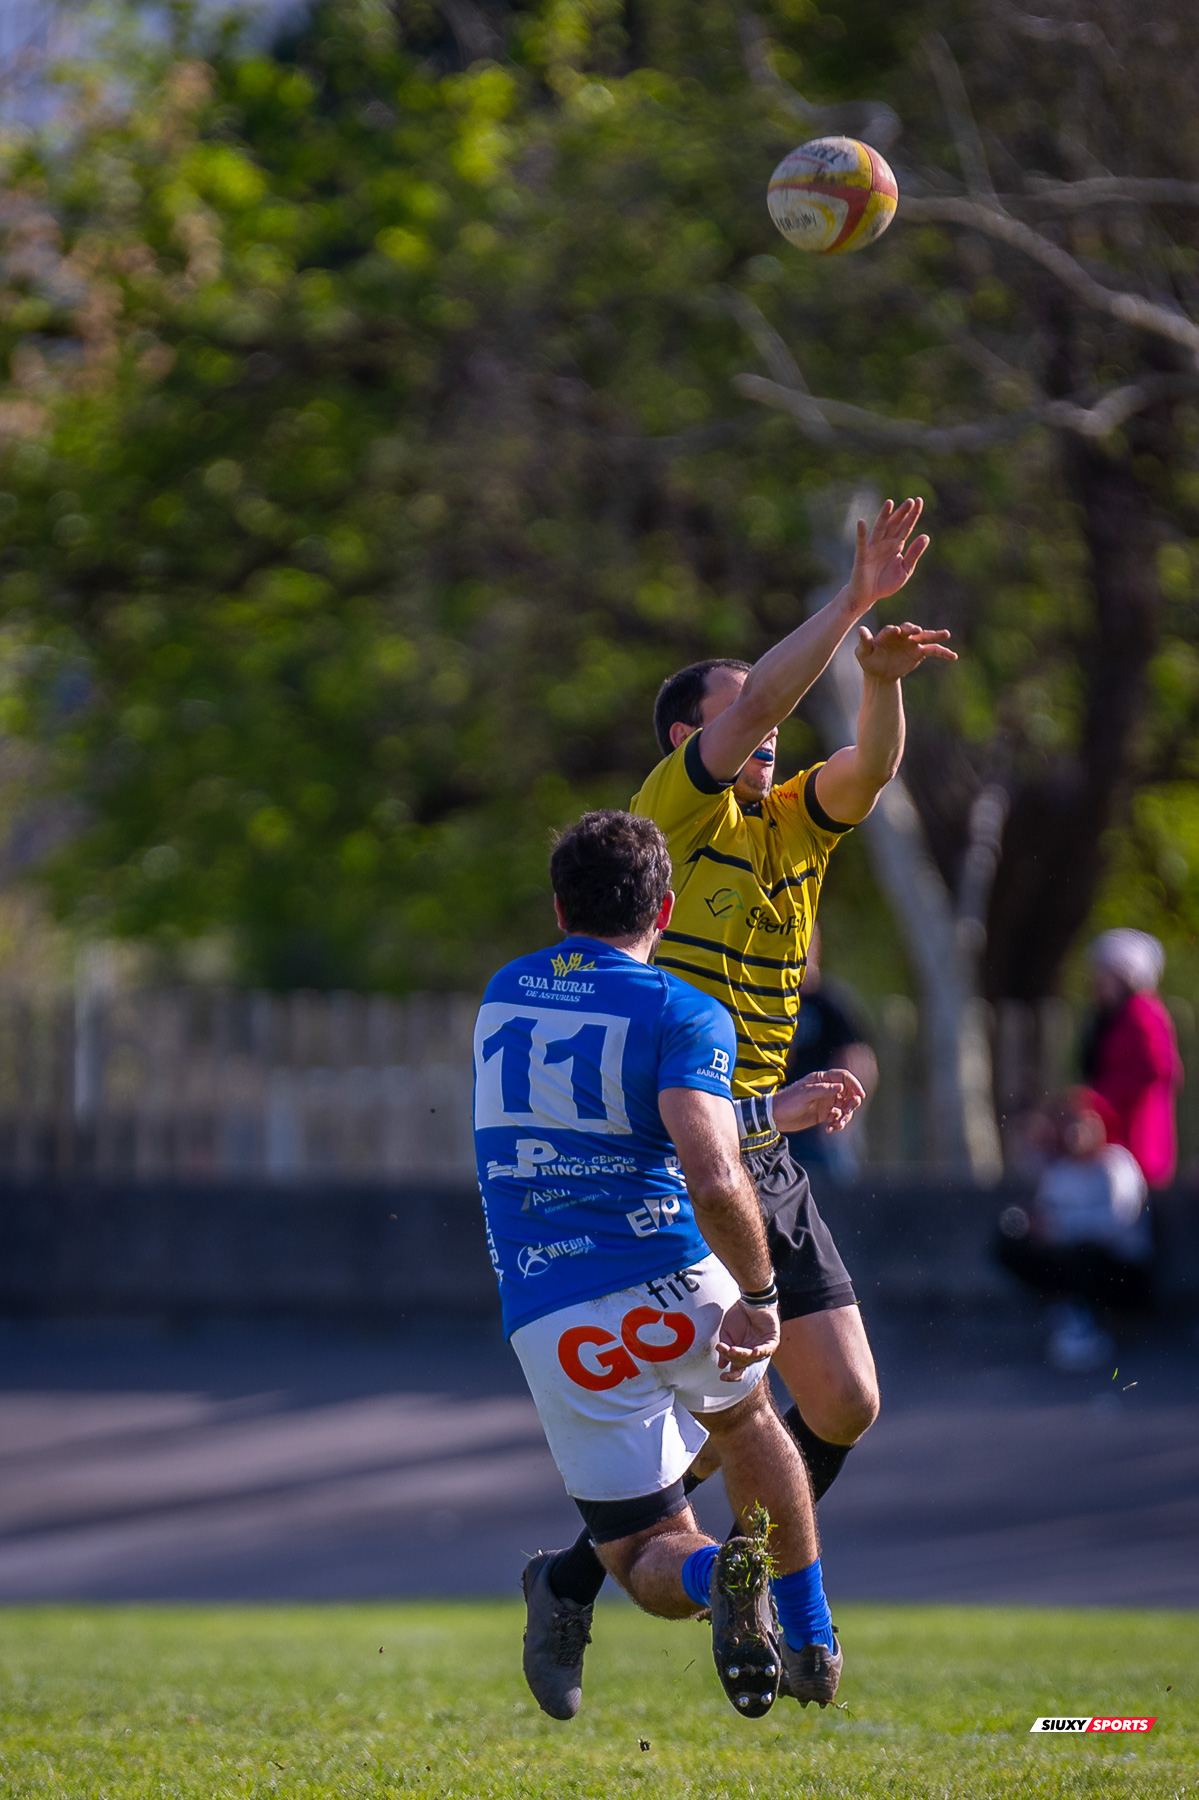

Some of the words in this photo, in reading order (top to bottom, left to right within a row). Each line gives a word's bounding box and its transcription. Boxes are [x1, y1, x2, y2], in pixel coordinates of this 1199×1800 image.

[518, 975, 549, 990] CAJA
[551, 979, 595, 994] RURAL
[525, 989, 537, 998] DE
[538, 992, 581, 1003] ASTURIAS
[482, 1016, 608, 1120] 11
[696, 1067, 720, 1081] BARRA
[645, 1270, 701, 1309] fit
[558, 1305, 696, 1391] GO
